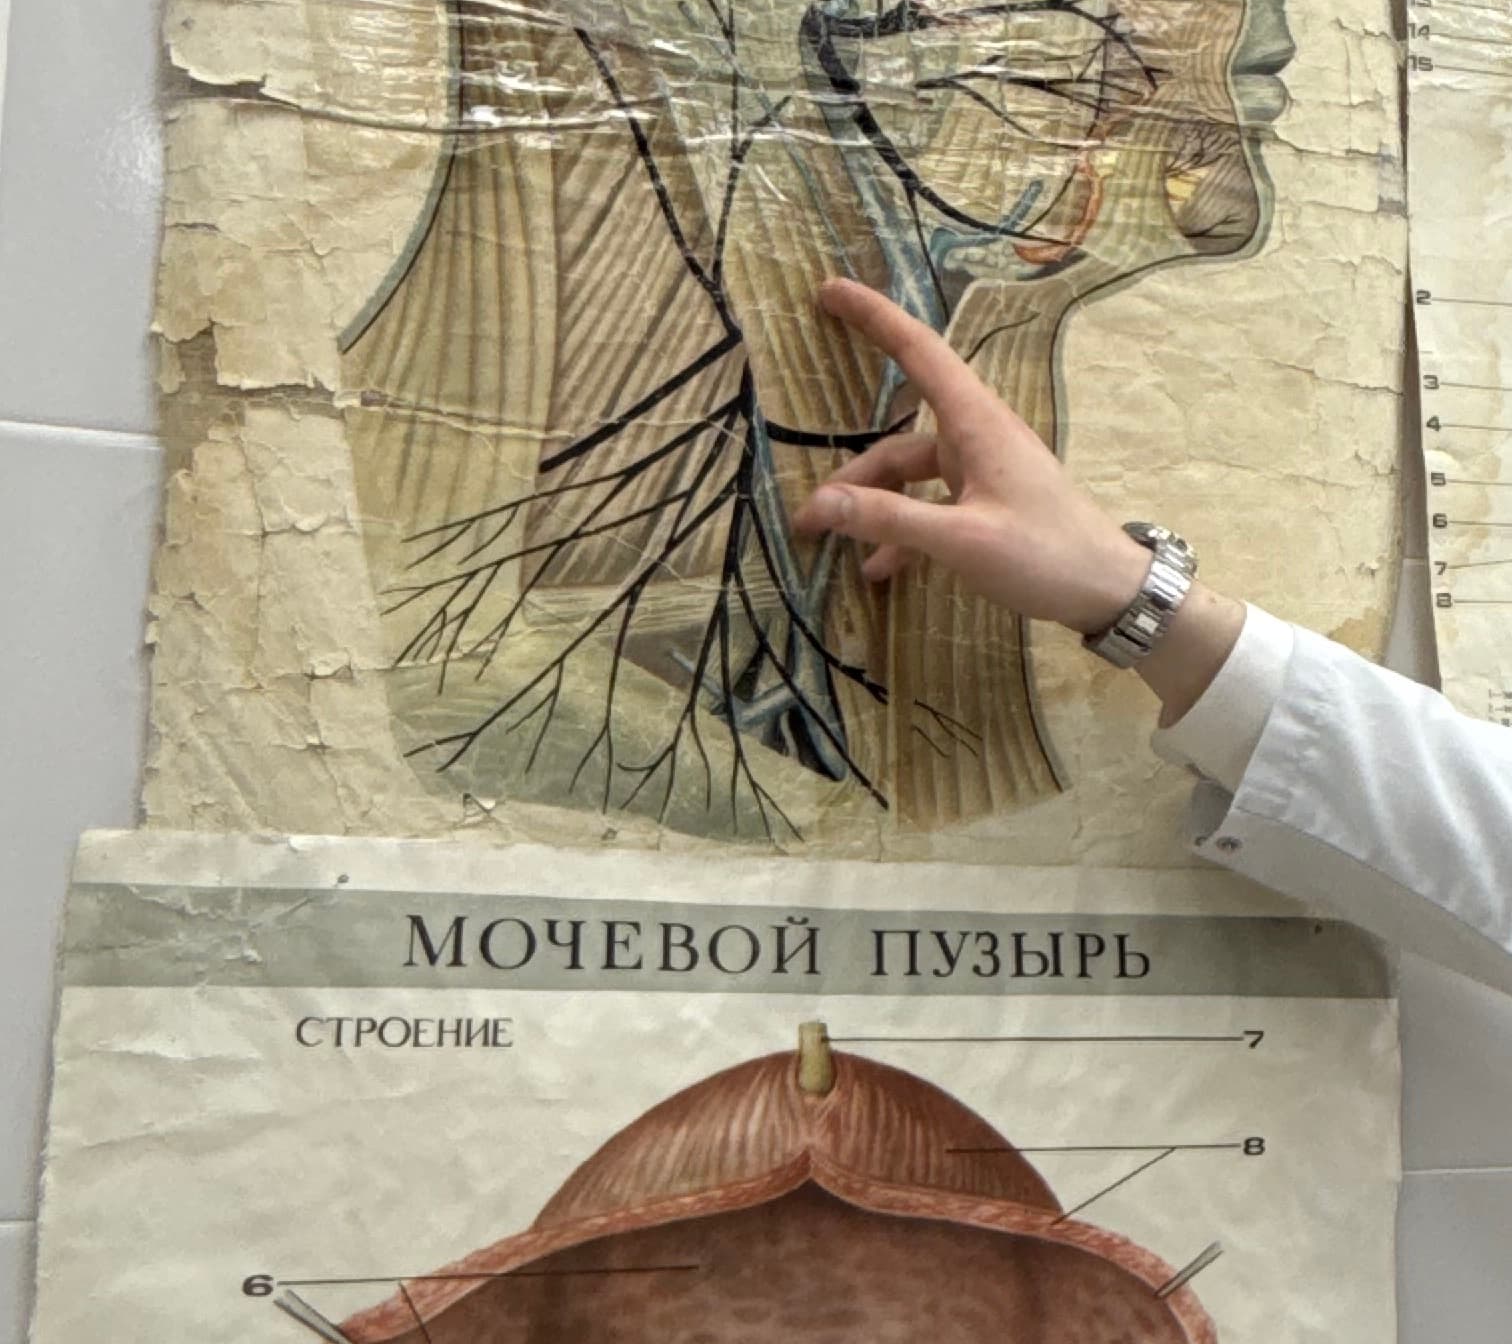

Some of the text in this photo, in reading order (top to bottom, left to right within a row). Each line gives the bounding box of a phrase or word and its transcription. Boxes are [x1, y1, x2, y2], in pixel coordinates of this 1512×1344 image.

[1407, 23, 1431, 39] 14
[1407, 56, 1433, 72] 15
[1416, 291, 1431, 305] 2
[1423, 375, 1439, 389] 3
[1427, 416, 1441, 431] 4
[1431, 473, 1446, 486] 5
[1433, 513, 1447, 528] 6
[1434, 561, 1447, 575] 7
[404, 913, 1151, 979] МОЧЕВОЙ ПУЗЫРЬ
[295, 1016, 513, 1048] СТРОЕНИЕ
[1243, 1031, 1265, 1049] 7
[1243, 1137, 1266, 1157] 8
[241, 1274, 274, 1298] 6
